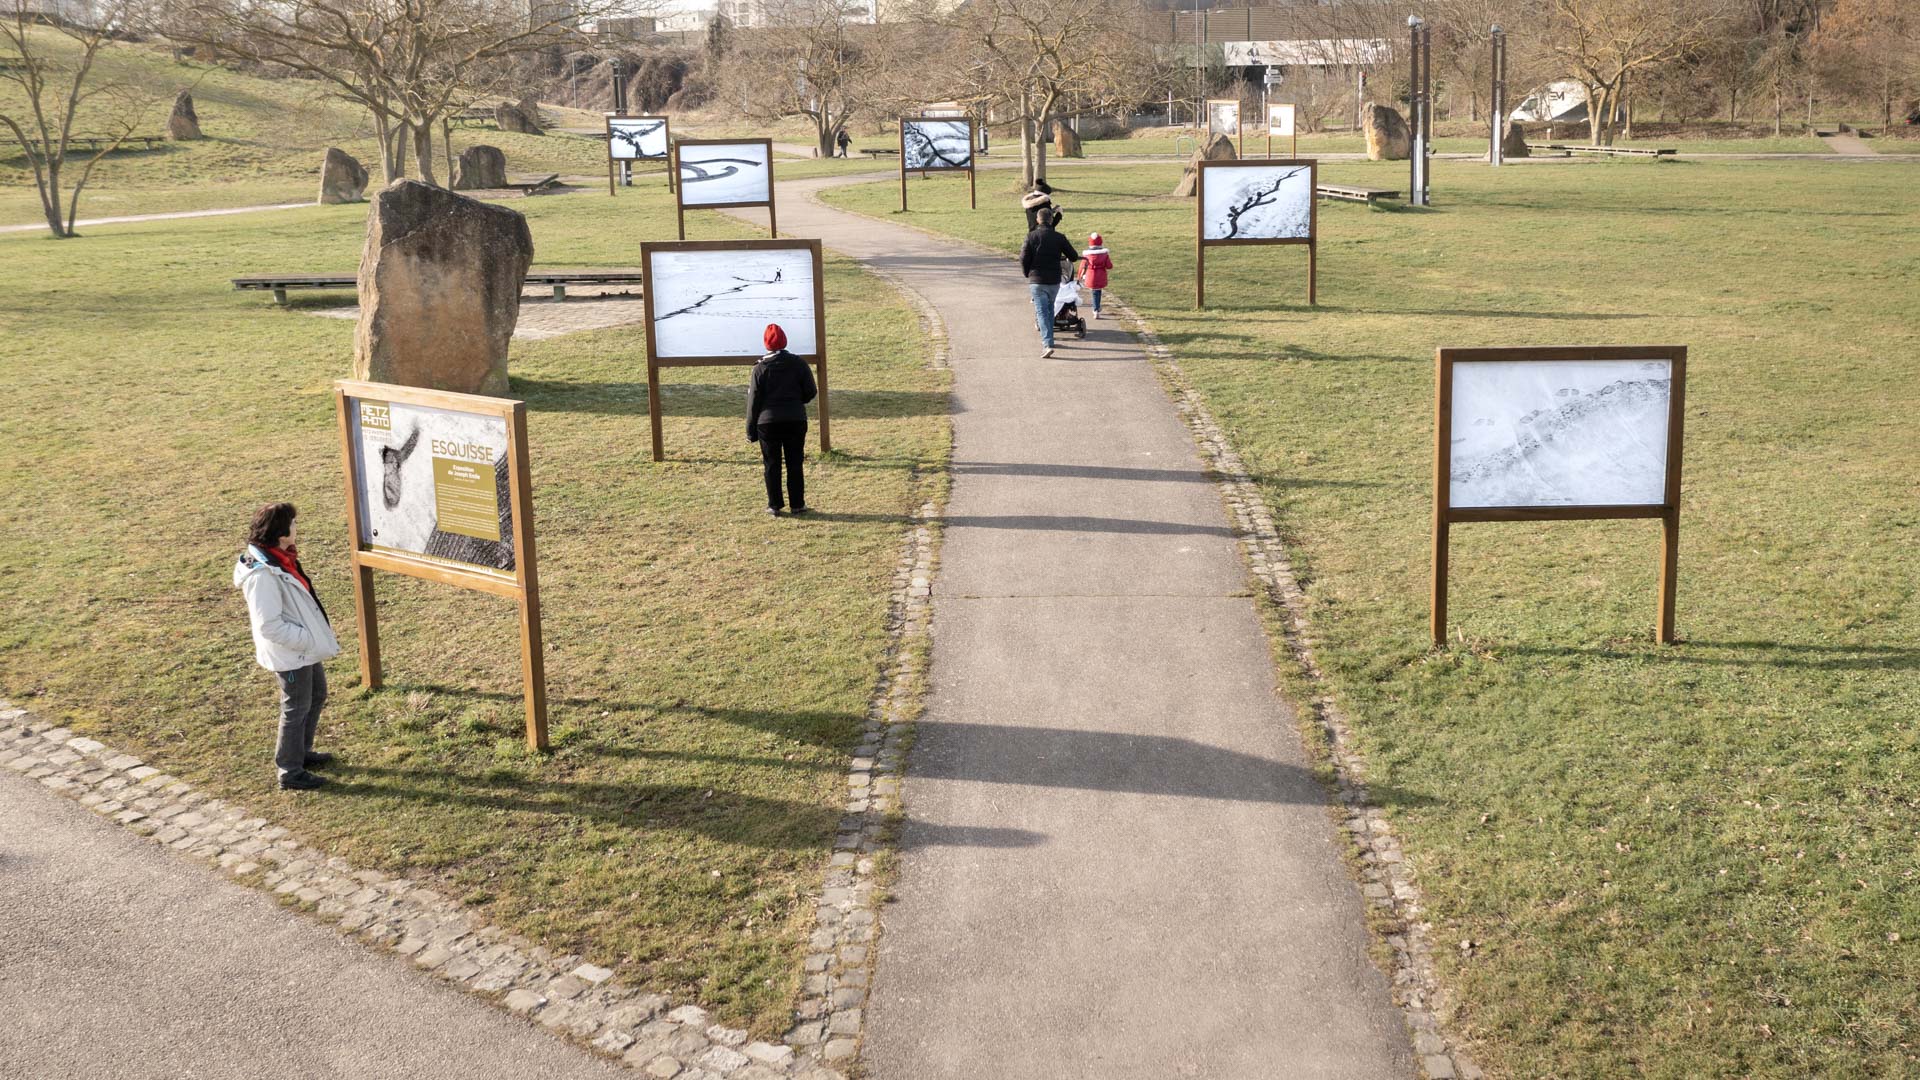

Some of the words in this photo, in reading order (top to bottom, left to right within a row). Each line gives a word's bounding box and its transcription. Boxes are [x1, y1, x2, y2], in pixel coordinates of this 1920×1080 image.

[360, 404, 389, 418] METZ
[361, 415, 390, 427] PHOTO
[431, 439, 494, 462] ESQUISSE
